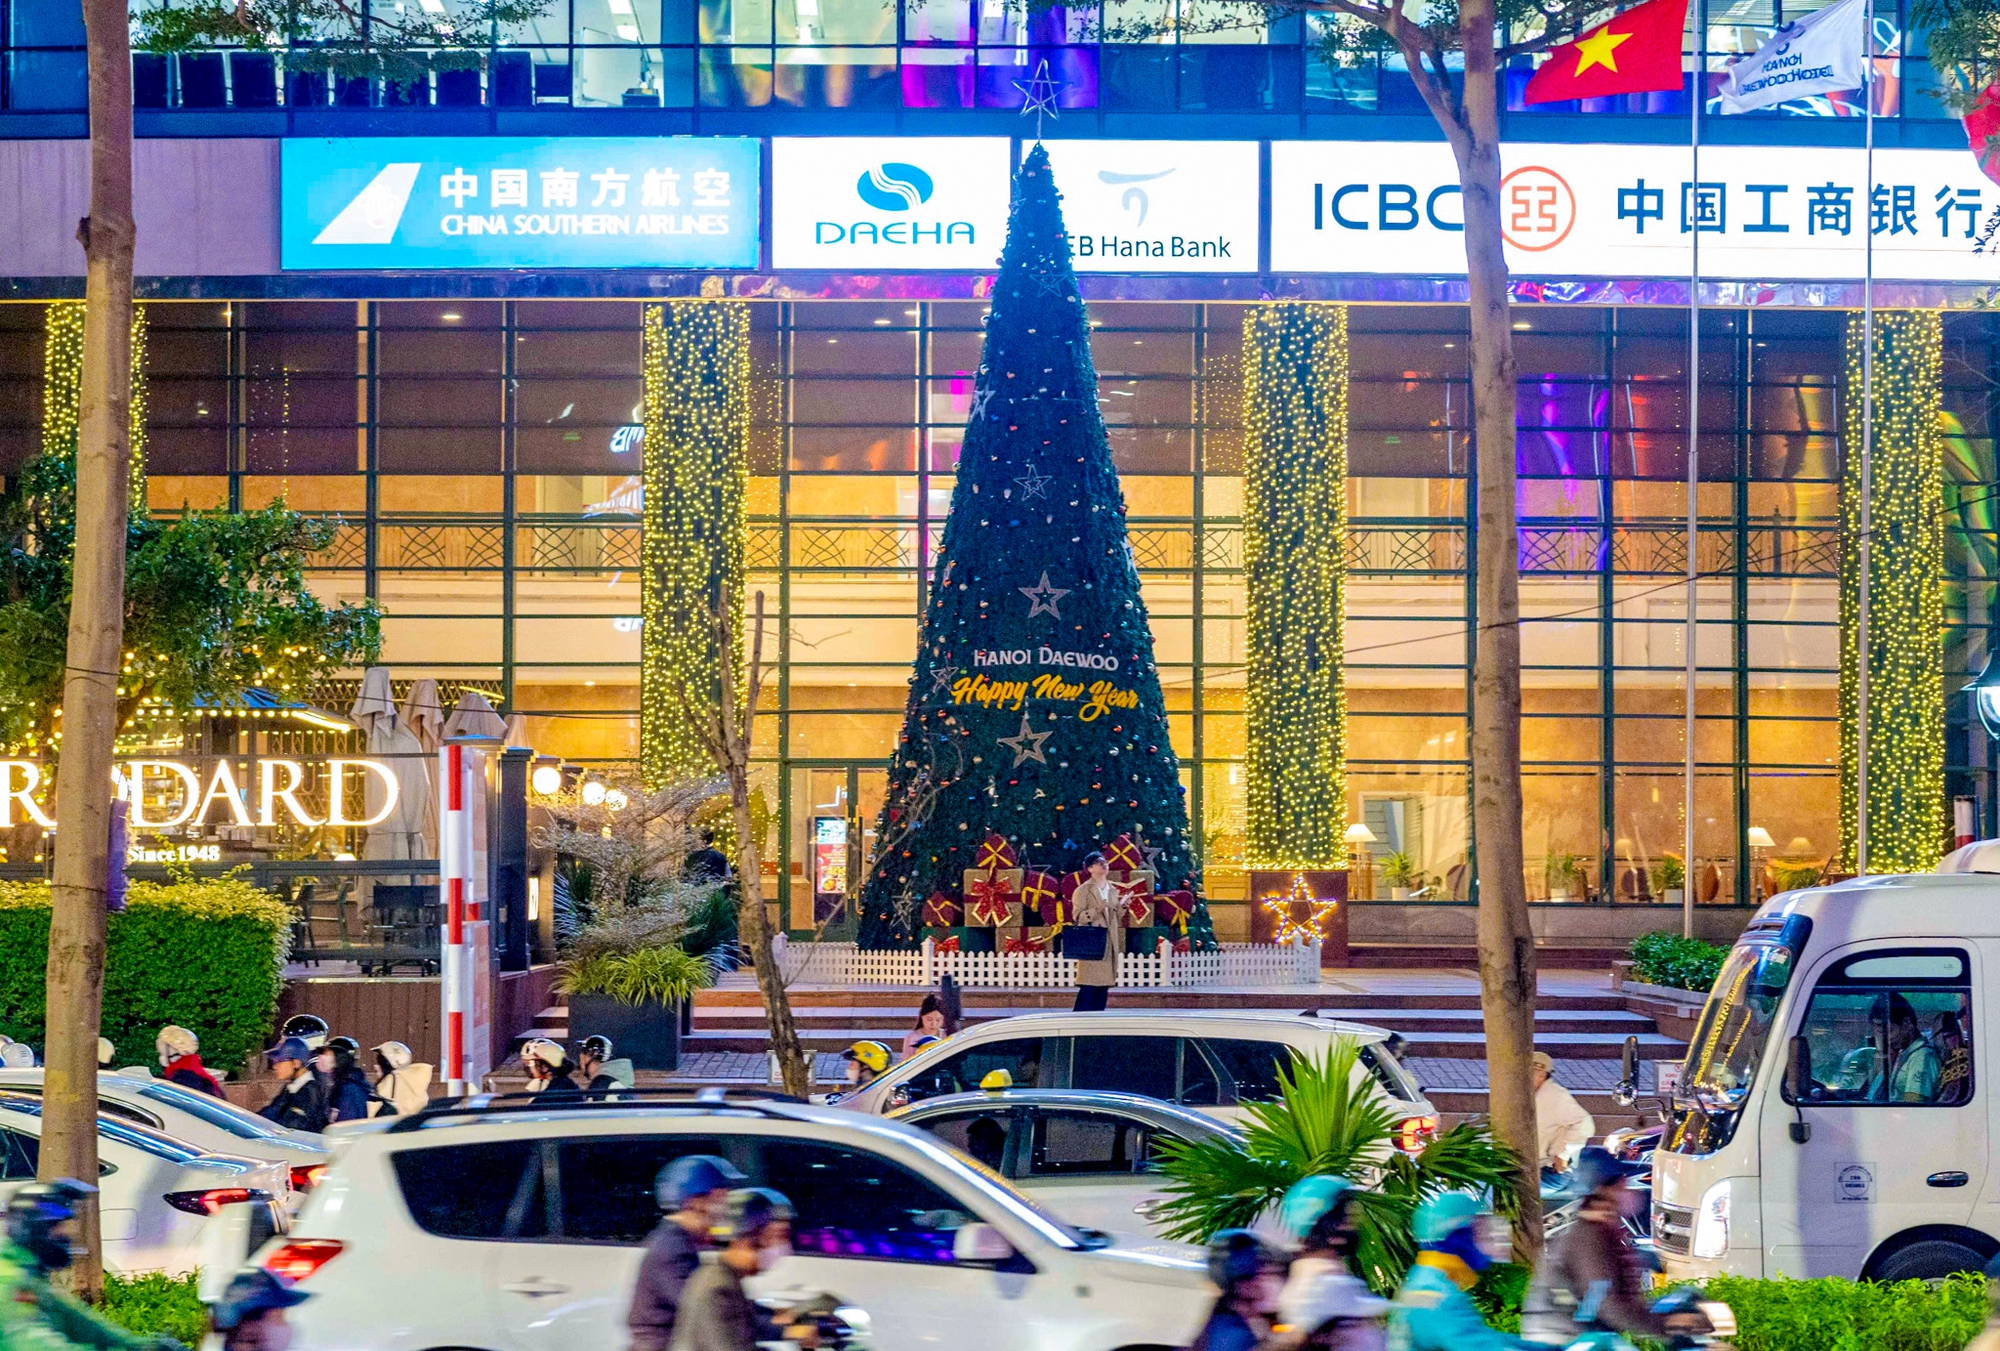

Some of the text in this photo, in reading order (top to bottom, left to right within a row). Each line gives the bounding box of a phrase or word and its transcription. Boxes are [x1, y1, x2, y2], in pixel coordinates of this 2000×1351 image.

[440, 167, 731, 208] 中国南方航空
[1314, 183, 1464, 231] ICBC
[1617, 178, 1983, 239] 中国工商银行
[440, 214, 730, 235] CHINA SOUTHERN AIRLINES
[815, 221, 975, 245] DAEHA
[1101, 235, 1165, 258] Hana
[1171, 235, 1232, 258] Bank
[973, 646, 1119, 671] HANOI DAEWOO
[950, 673, 1139, 722] Happy New Year
[127, 844, 221, 862] Since 1948
